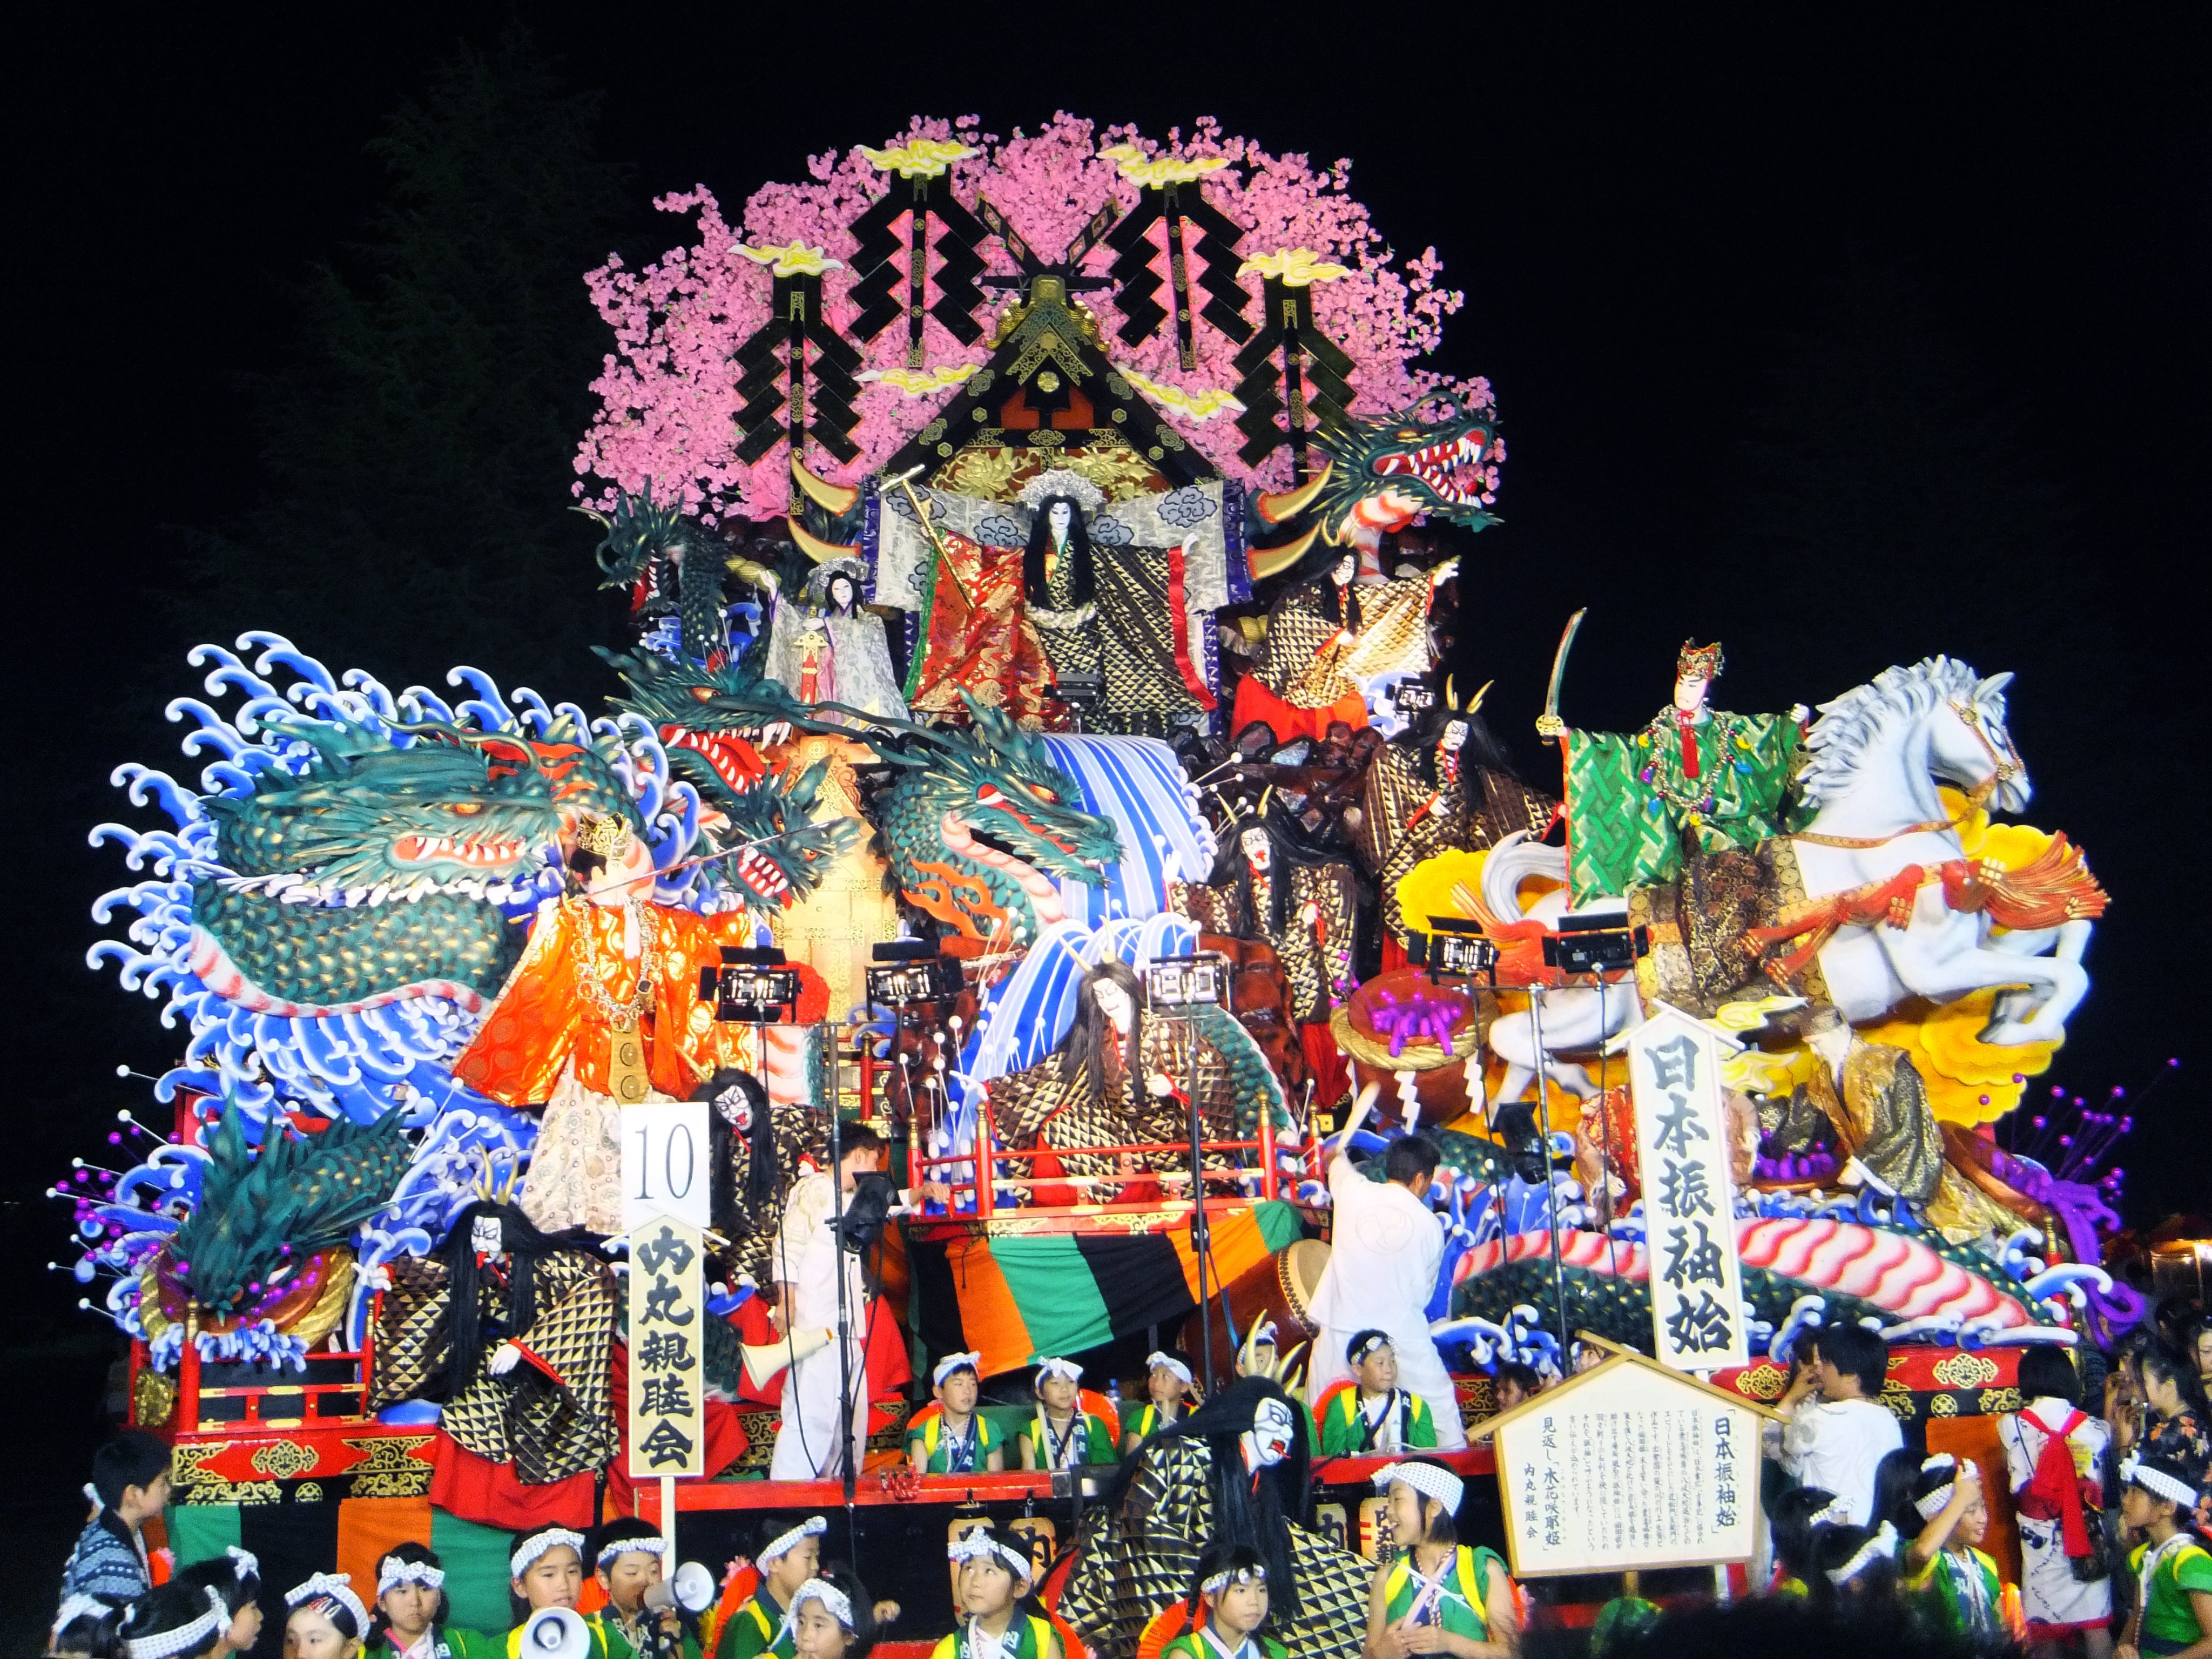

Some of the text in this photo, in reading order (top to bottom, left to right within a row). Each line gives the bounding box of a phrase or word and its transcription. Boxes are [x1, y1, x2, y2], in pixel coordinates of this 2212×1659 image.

[633, 1123, 694, 1200] 10
[1644, 1034, 1732, 1354] 日本振袖始
[636, 1225, 696, 1469] 内丸親睦会
[1524, 1462, 1538, 1539] 内丸親睦会
